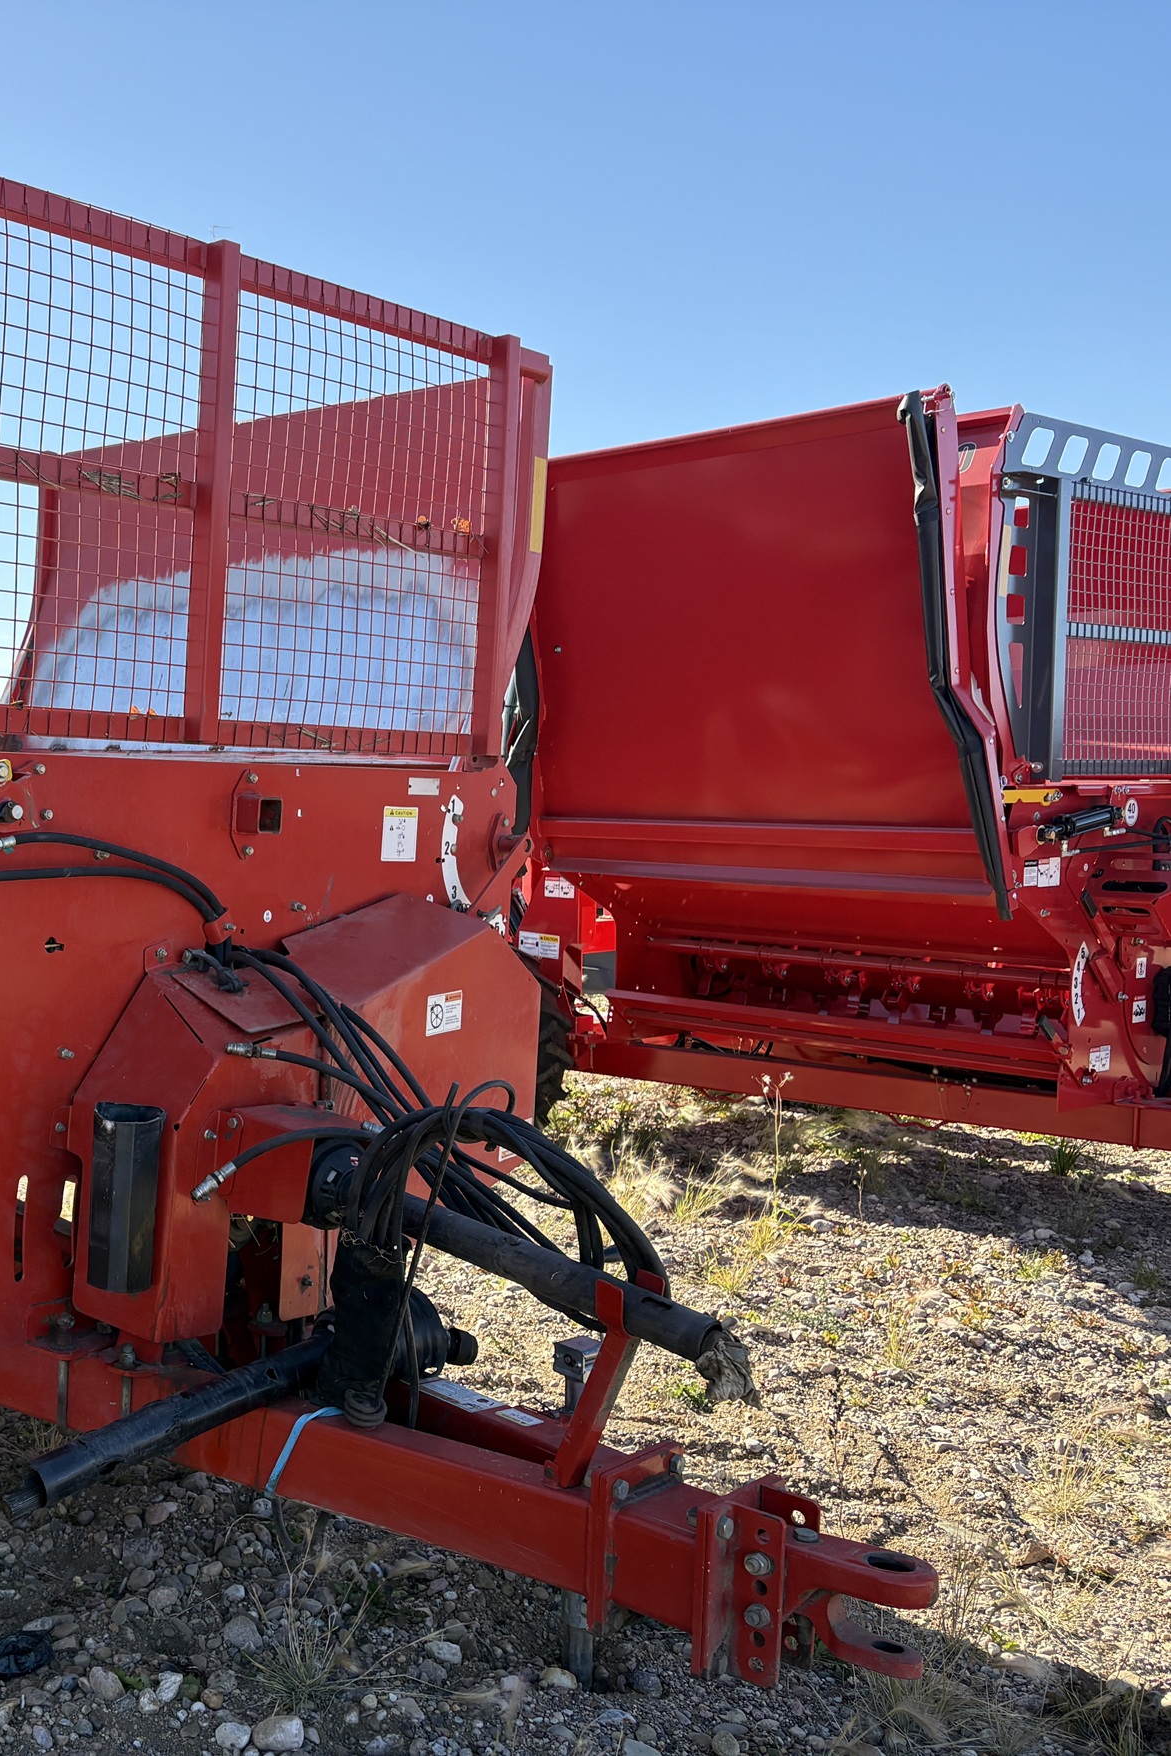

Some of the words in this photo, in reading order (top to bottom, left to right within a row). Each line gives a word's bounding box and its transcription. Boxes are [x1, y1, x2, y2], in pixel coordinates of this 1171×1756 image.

[450, 798, 456, 813] 1
[1128, 802, 1136, 814] 40
[444, 841, 450, 855] 2
[451, 885, 457, 899] 3
[1080, 947, 1086, 959] 5
[1076, 961, 1081, 972] 4
[1073, 977, 1079, 989] 3
[1074, 993, 1079, 1004] 2
[1076, 1008, 1081, 1019] 1
